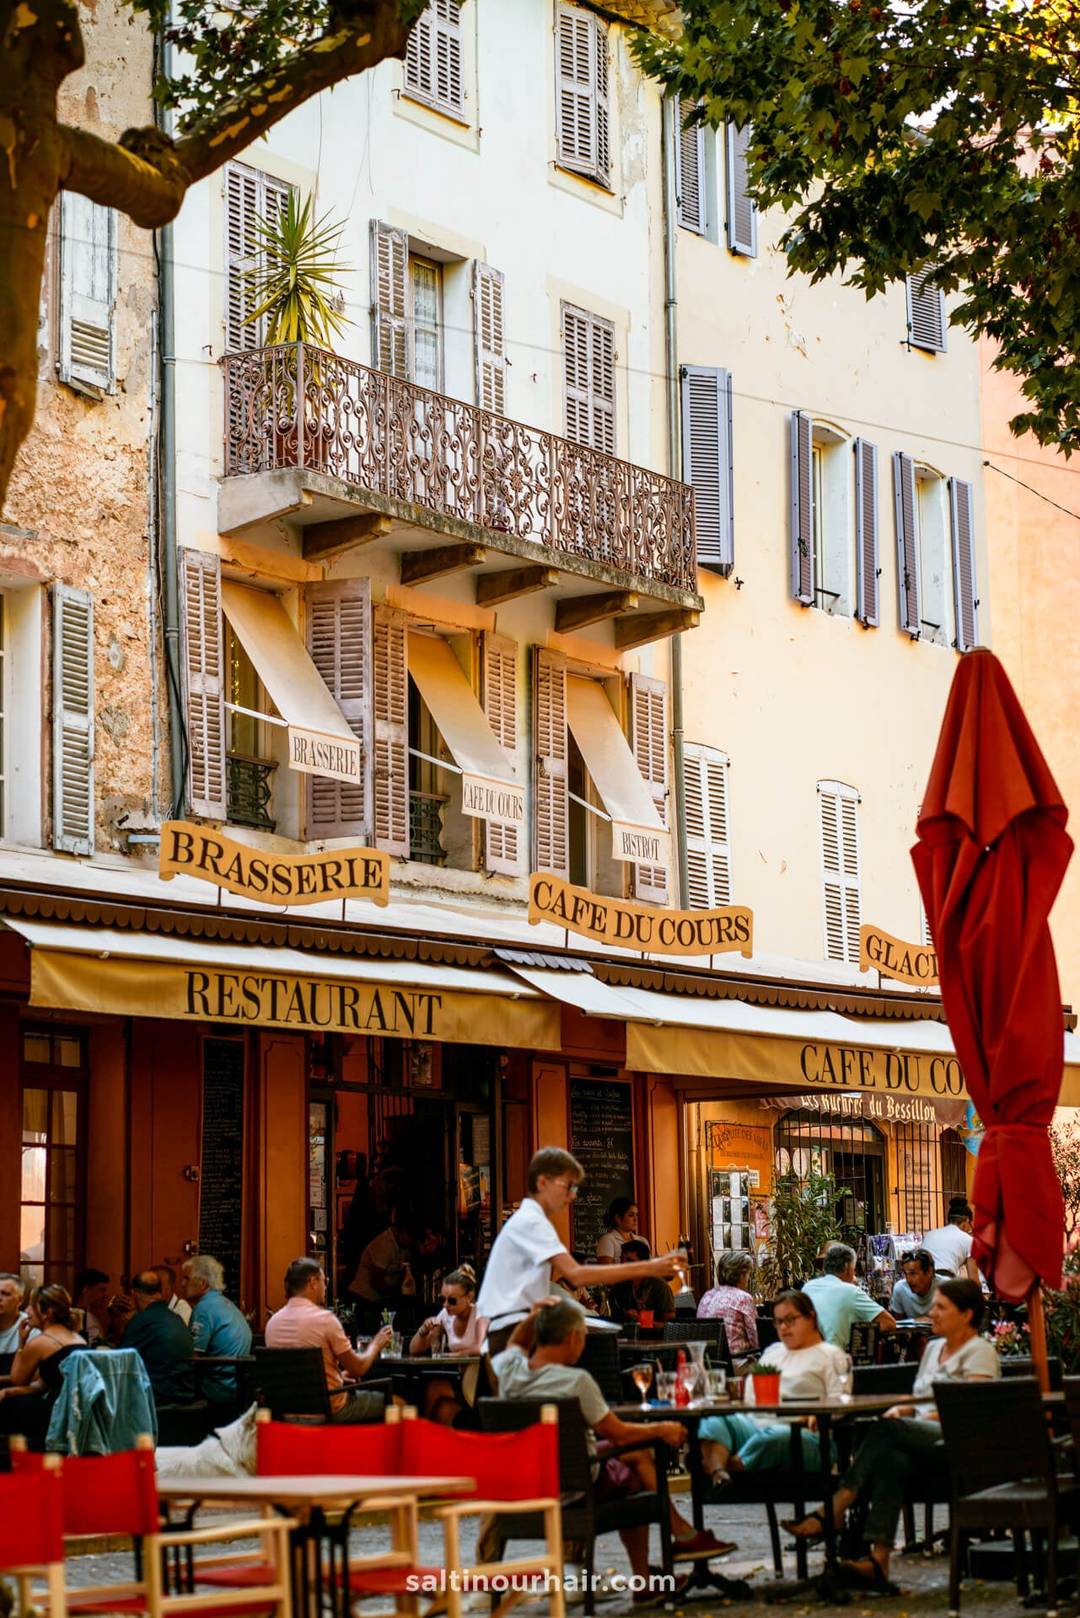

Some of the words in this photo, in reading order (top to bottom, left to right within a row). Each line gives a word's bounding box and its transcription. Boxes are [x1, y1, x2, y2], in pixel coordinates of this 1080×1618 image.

[293, 736, 357, 776] BRASSERIE
[464, 783, 484, 811] CAFE
[498, 791, 524, 820] COURS
[168, 830, 384, 896] BRASSERIE
[622, 831, 661, 861] BISTROT
[533, 880, 608, 934] CAFE
[613, 909, 656, 943] DU
[658, 914, 750, 947] COURS
[184, 970, 443, 1036] RESTAURANT
[800, 1044, 876, 1088] CAFE
[883, 1053, 921, 1092] DU
[869, 1094, 883, 1116] du
[885, 1094, 936, 1122] Bessillon
